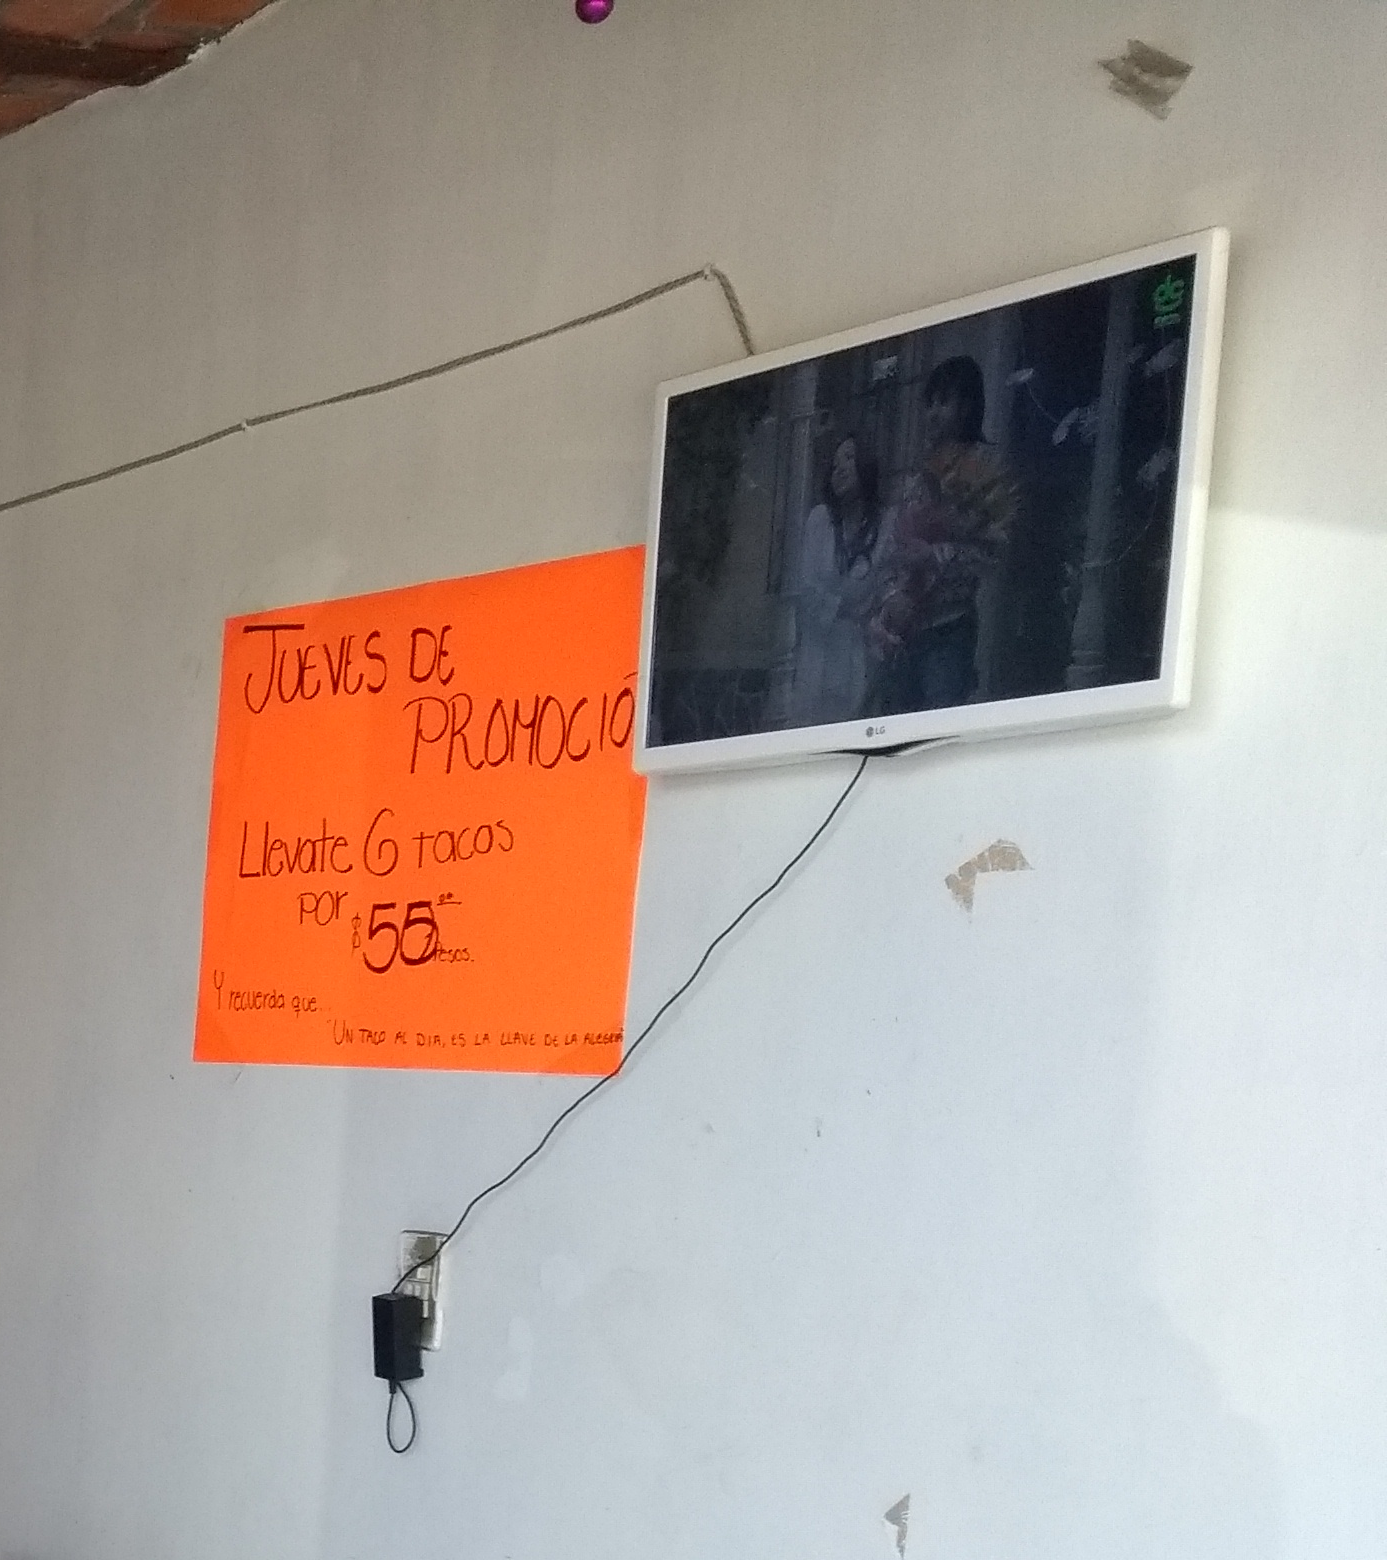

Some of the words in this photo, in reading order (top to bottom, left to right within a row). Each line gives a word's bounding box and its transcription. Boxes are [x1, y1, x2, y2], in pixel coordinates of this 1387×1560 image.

[243, 624, 387, 714] JUEVES
[410, 625, 454, 686] DE
[239, 818, 353, 878] Llevate
[364, 808, 398, 876] 6
[413, 820, 514, 868] tacos
[213, 969, 225, 1010] Y
[228, 988, 285, 1012] recuerda
[500, 1031, 536, 1046] LLAVE
